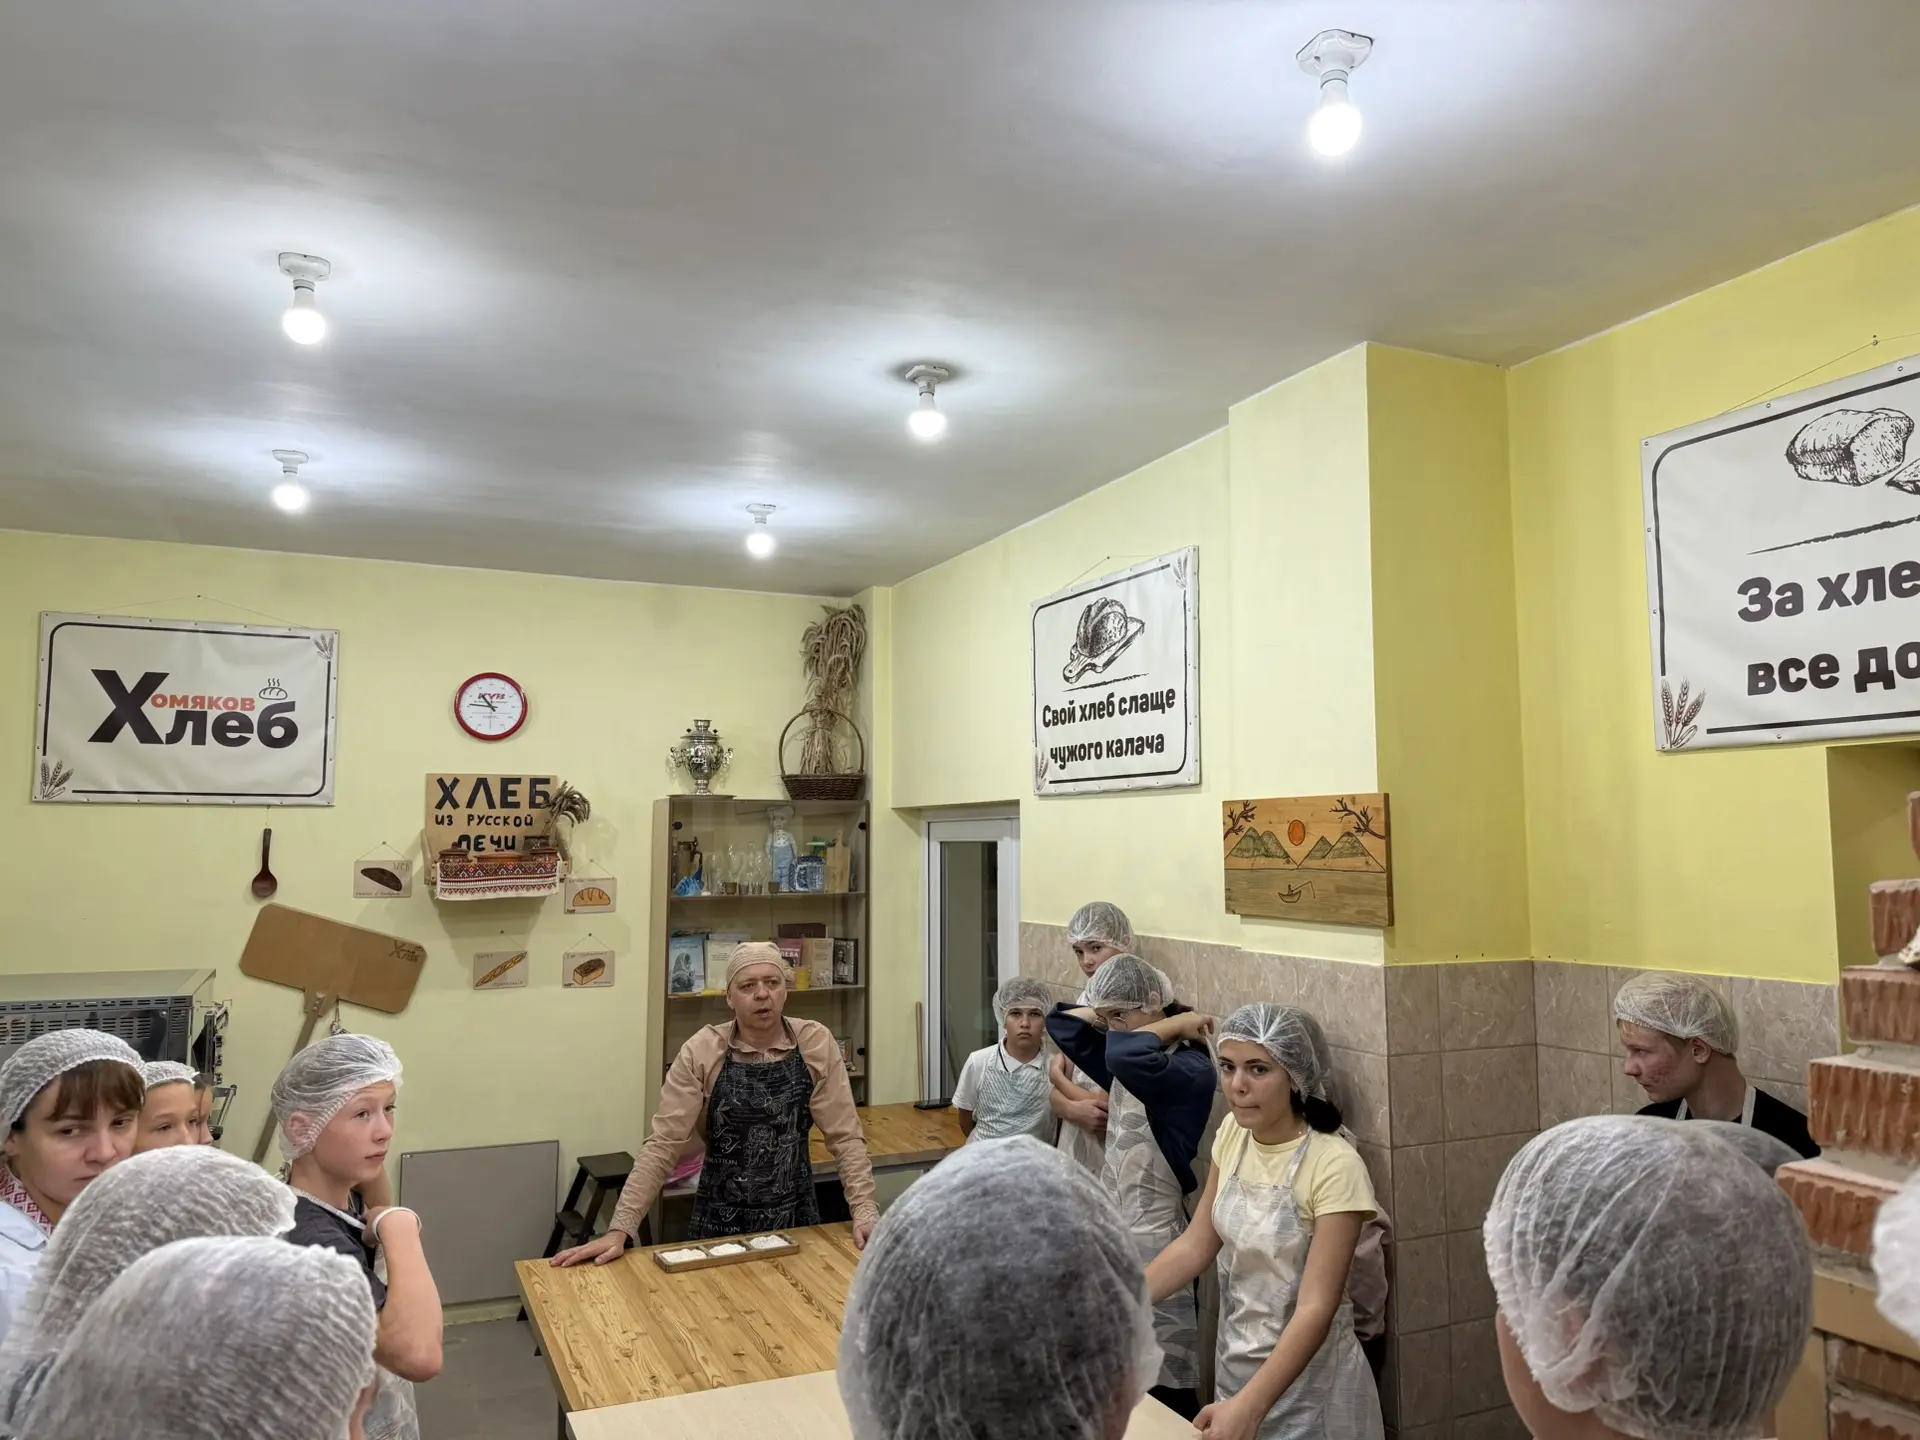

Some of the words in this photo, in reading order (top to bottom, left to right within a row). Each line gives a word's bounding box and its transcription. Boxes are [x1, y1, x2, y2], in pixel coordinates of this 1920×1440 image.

[1737, 576, 1804, 623] За
[1747, 653, 1840, 697] все
[1853, 641, 1920, 694] до
[87, 668, 299, 749] Хлеб
[1042, 699, 1076, 728] Свой
[1078, 691, 1115, 722] хлеб
[1118, 688, 1176, 715] слаще
[1050, 741, 1103, 770] чужого
[1105, 733, 1165, 759] калача
[434, 776, 552, 810] ХЛЕБ
[467, 814, 534, 828] РУССКОЙ
[457, 834, 516, 852] ПЕЧИ
